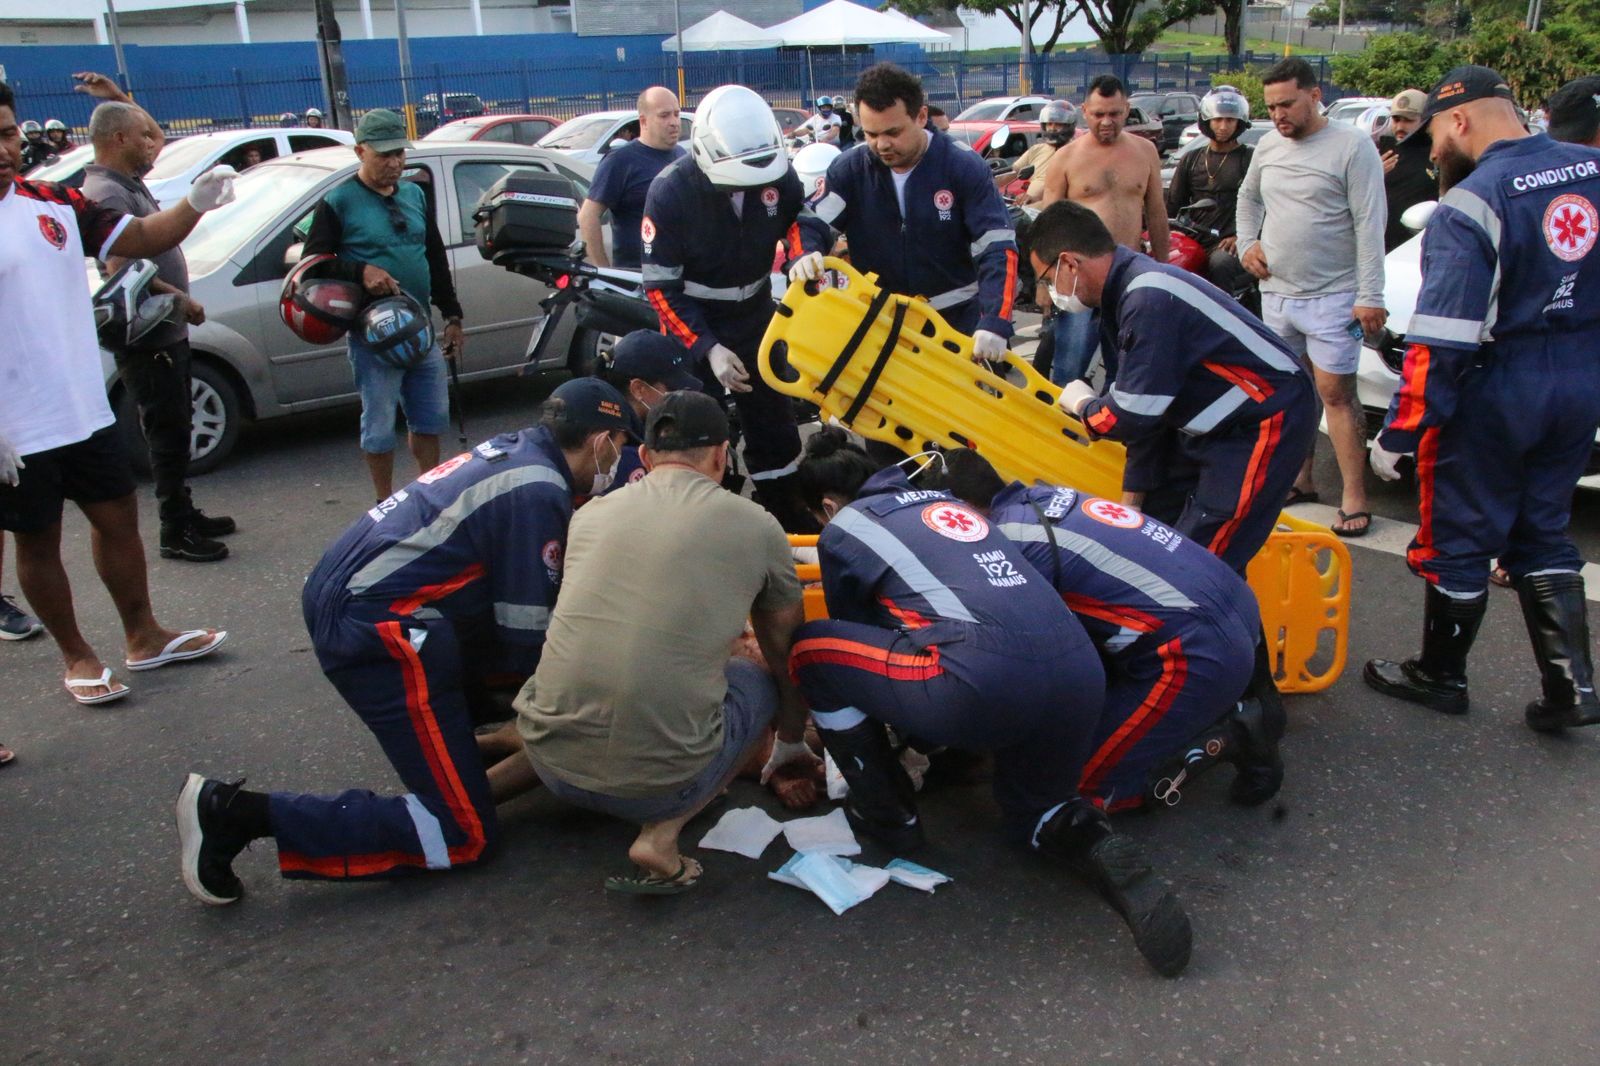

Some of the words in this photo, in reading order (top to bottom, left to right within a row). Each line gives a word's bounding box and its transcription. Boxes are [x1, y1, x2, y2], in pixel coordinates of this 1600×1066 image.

[1513, 160, 1599, 191] CONDUTOR
[1151, 526, 1173, 545] 192
[972, 549, 1006, 563] SAMU
[979, 560, 1018, 577] 192
[987, 574, 1027, 587] MANAUS
